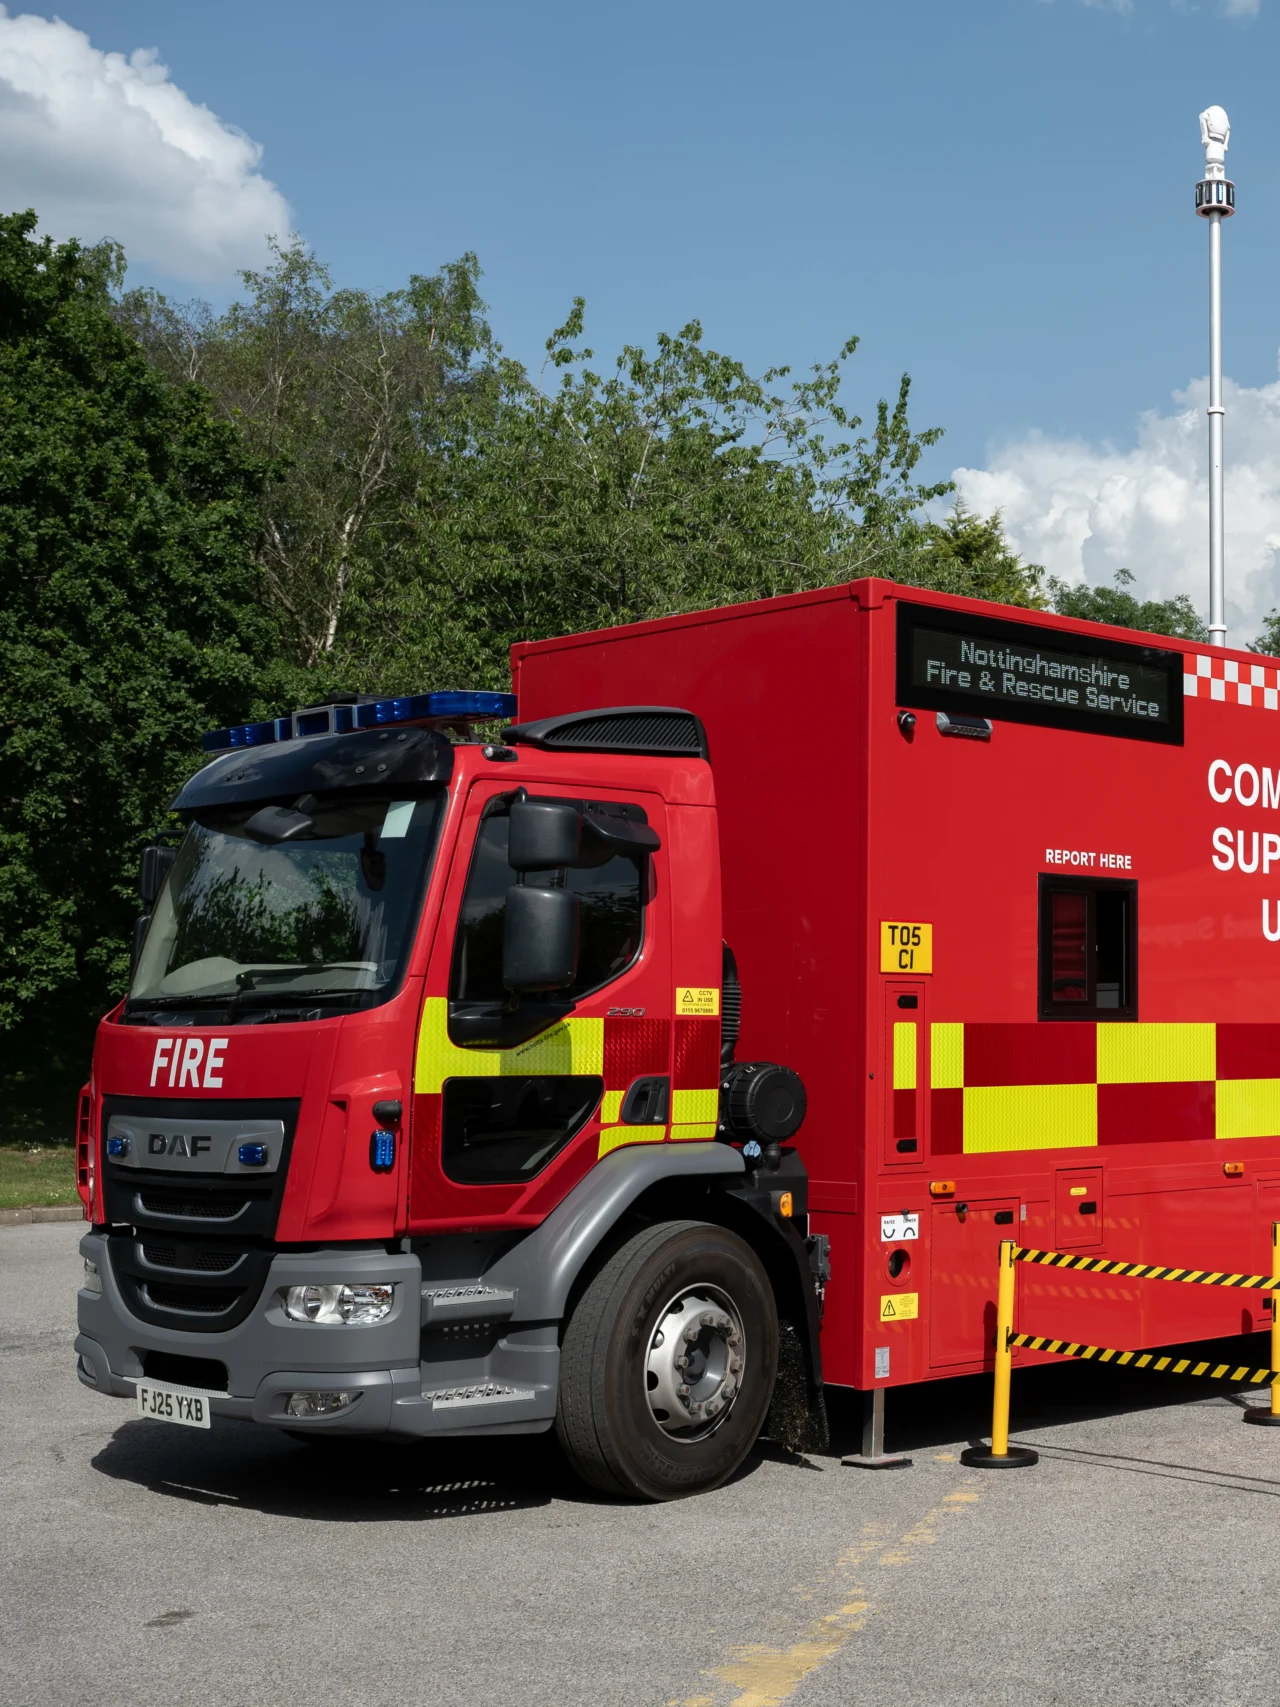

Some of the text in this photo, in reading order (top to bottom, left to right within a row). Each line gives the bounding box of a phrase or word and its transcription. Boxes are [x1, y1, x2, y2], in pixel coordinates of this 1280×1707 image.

[961, 640, 1130, 690] Nottinghamshire
[927, 659, 1160, 717] Fire & Rescue Service
[1045, 848, 1132, 870] REPORT HERE
[606, 1006, 646, 1018] 290
[150, 1038, 229, 1088] FIRE
[148, 1133, 212, 1158] DAF
[141, 1388, 204, 1422] FJ25 YXB
